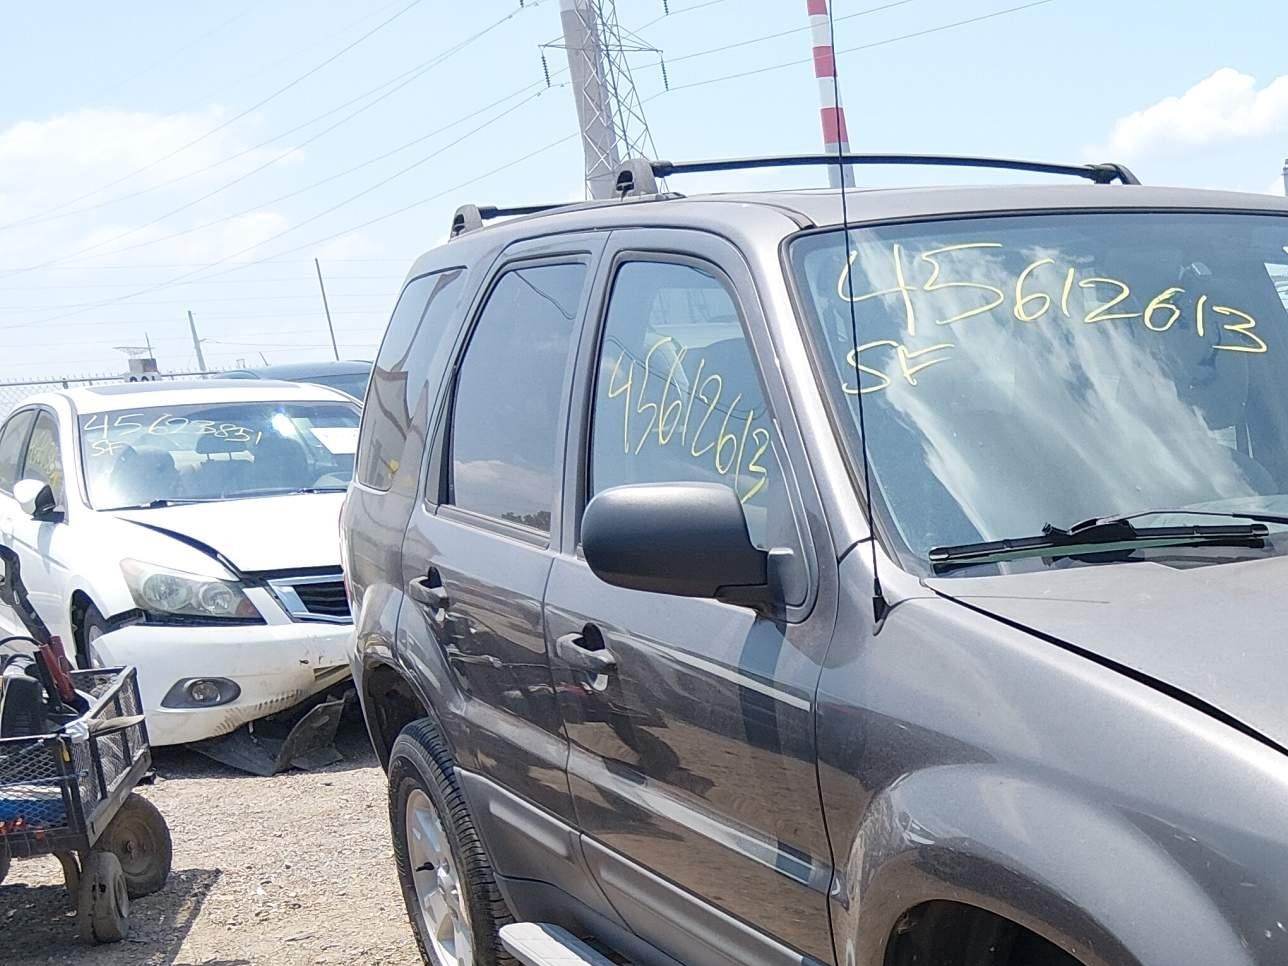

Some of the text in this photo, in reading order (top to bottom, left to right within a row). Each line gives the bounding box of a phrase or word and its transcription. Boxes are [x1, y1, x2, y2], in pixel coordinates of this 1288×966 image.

[838, 243, 1268, 354] 45612613
[608, 336, 770, 504] 45612613
[842, 339, 955, 395] SF
